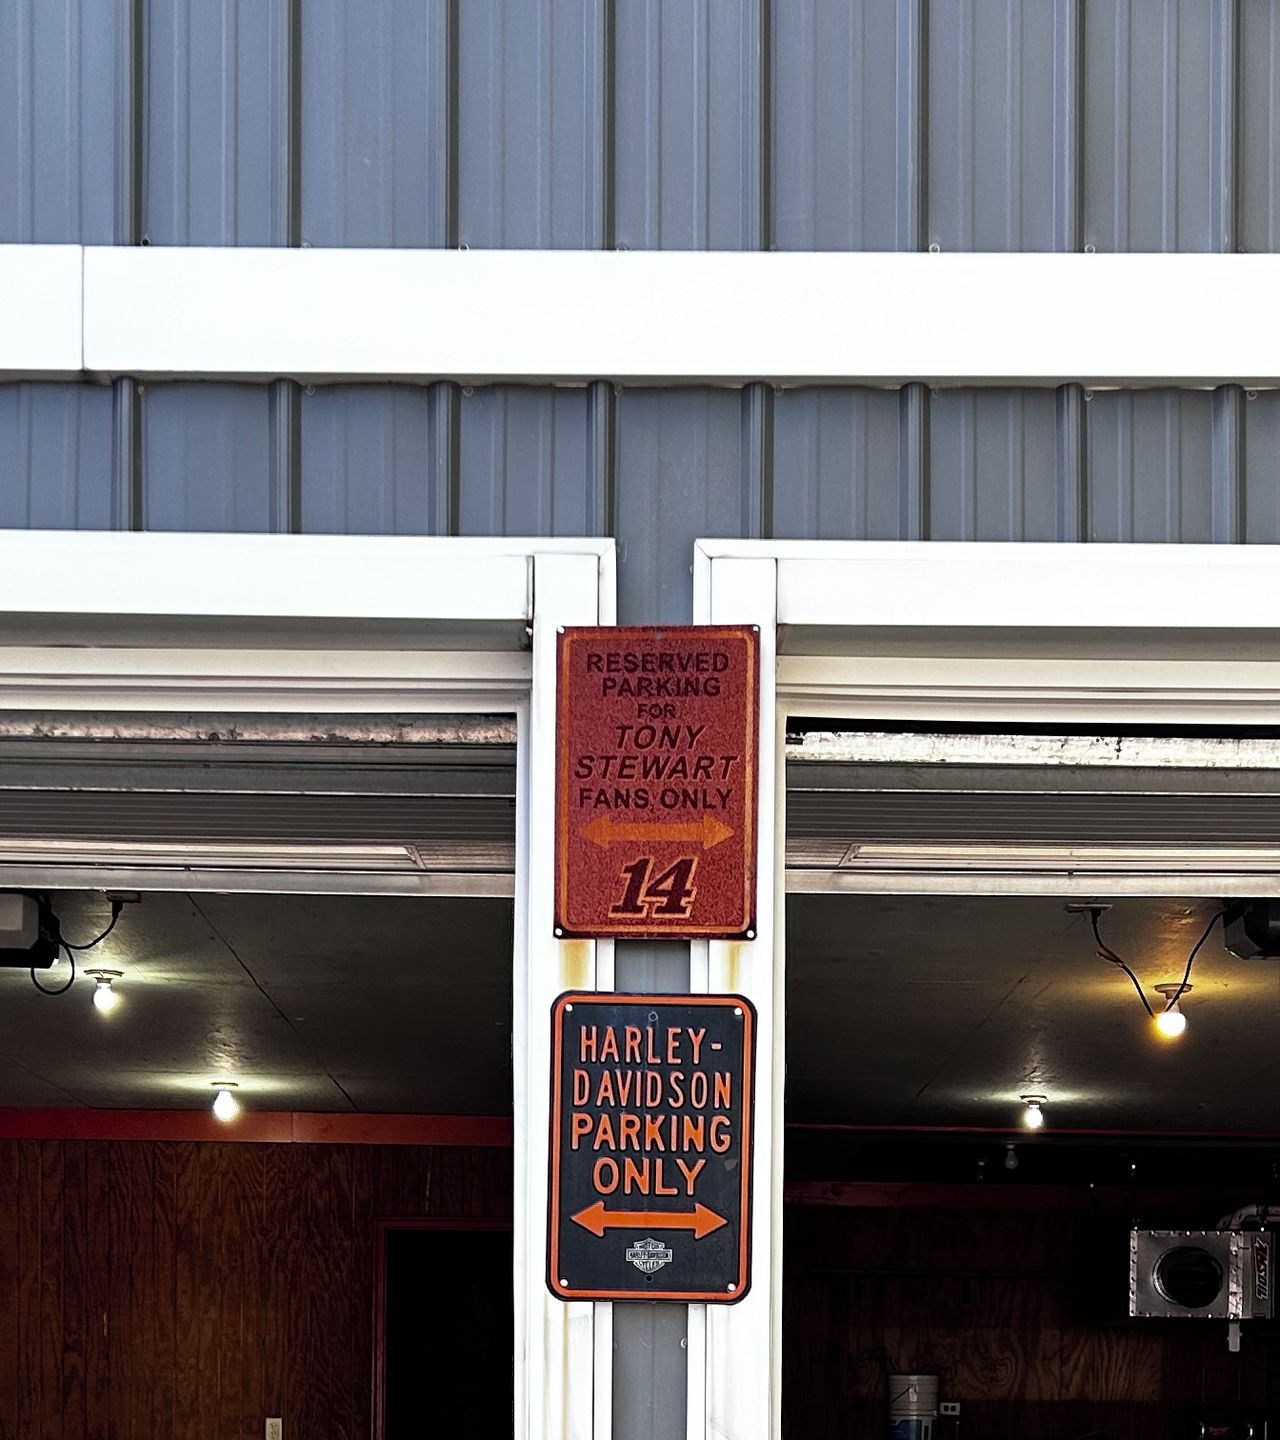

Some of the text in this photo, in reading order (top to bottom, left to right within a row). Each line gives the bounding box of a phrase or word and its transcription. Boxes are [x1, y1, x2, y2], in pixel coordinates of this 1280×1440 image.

[586, 651, 730, 674] RESERVED
[602, 676, 721, 698] PARKING
[637, 702, 676, 719] FOR
[614, 724, 706, 750] TONY
[574, 755, 741, 781] STEWART
[579, 787, 734, 810] FANS ONLY
[608, 856, 699, 919] 14
[580, 1025, 723, 1065] HARLEY-
[573, 1069, 732, 1110] DAVIDSON
[571, 1112, 732, 1154] PARKING
[592, 1156, 707, 1196] ONLY
